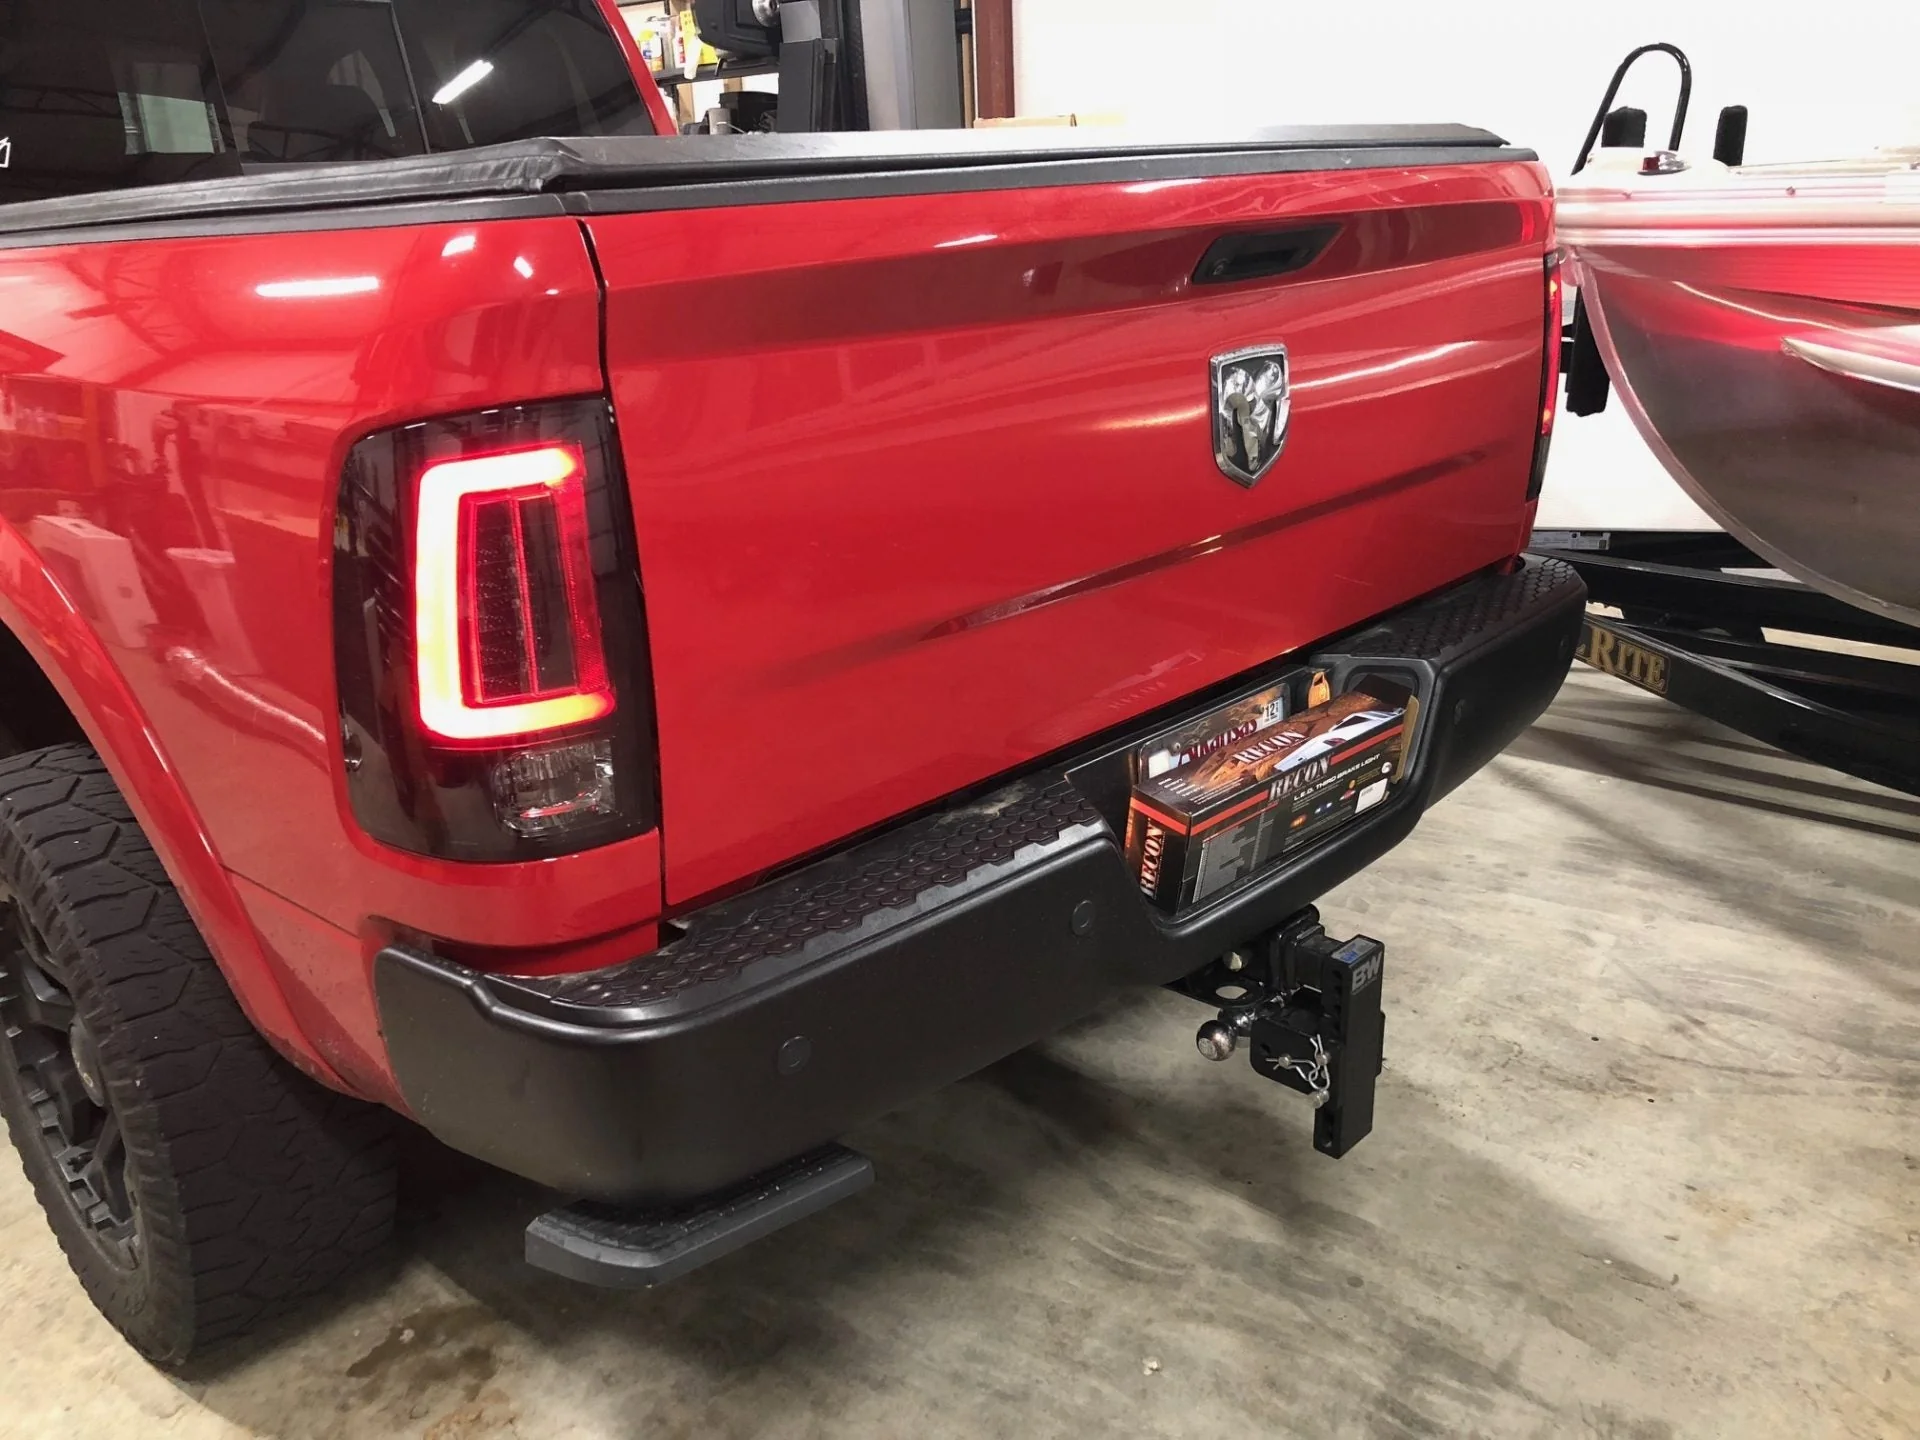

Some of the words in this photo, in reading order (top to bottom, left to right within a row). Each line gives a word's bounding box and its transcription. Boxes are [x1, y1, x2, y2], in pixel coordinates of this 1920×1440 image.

[1587, 626, 1665, 689] RITE
[1232, 729, 1308, 764] RECON
[1269, 753, 1334, 802] RECON
[1140, 818, 1163, 898] RECON
